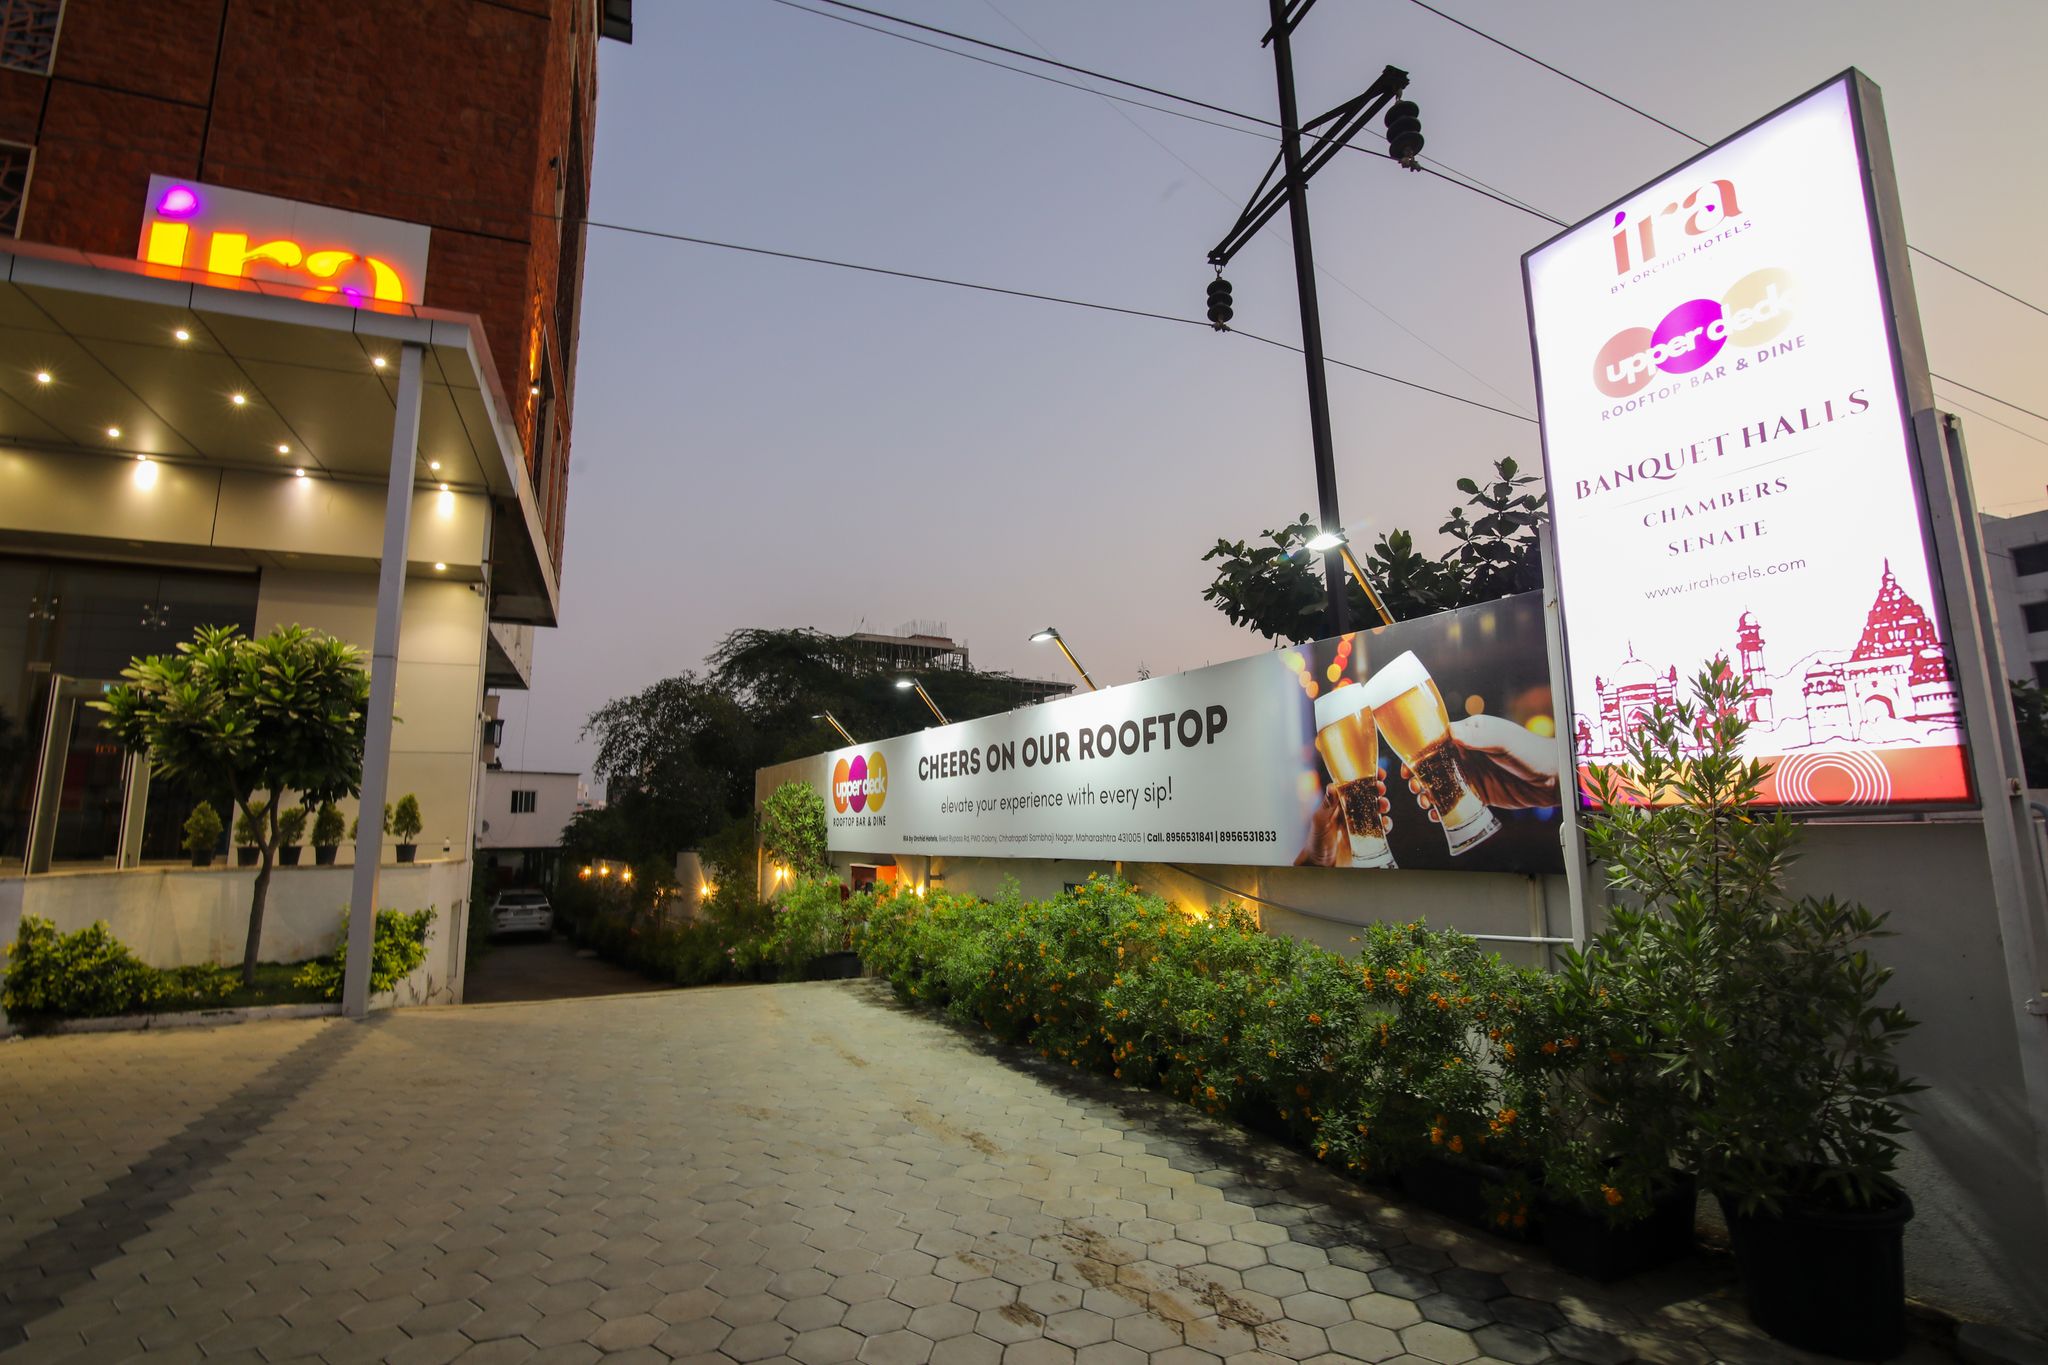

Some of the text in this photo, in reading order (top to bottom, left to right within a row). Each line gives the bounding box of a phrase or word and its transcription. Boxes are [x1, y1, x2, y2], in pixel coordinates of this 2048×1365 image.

[1612, 179, 1743, 276] ira
[1611, 220, 1752, 294] BY ORCHID HOTELS
[1601, 335, 1806, 421] ROOFTOP BAR & DINE
[1606, 326, 1704, 385] upper
[1576, 389, 1869, 499] BANQUET HALLS
[1643, 476, 1788, 528] CHAMBERS
[1668, 520, 1768, 556] SENATE
[1645, 558, 1806, 599] www.irahotels.com
[918, 704, 1228, 781] CHEERS ON OUR ROOFTOP
[836, 767, 886, 804] upper deck
[941, 775, 1173, 817] elevate your experience with every sip!
[833, 817, 855, 827] ROOFTOP
[856, 816, 866, 827] BAR
[873, 815, 887, 826] DINE
[999, 833, 1029, 844] Chhatrapati
[1029, 833, 1054, 844] Sambhaji
[1055, 832, 1075, 845] Nagar,
[1075, 832, 1117, 843] Maharashtra
[1118, 832, 1142, 843] 431005
